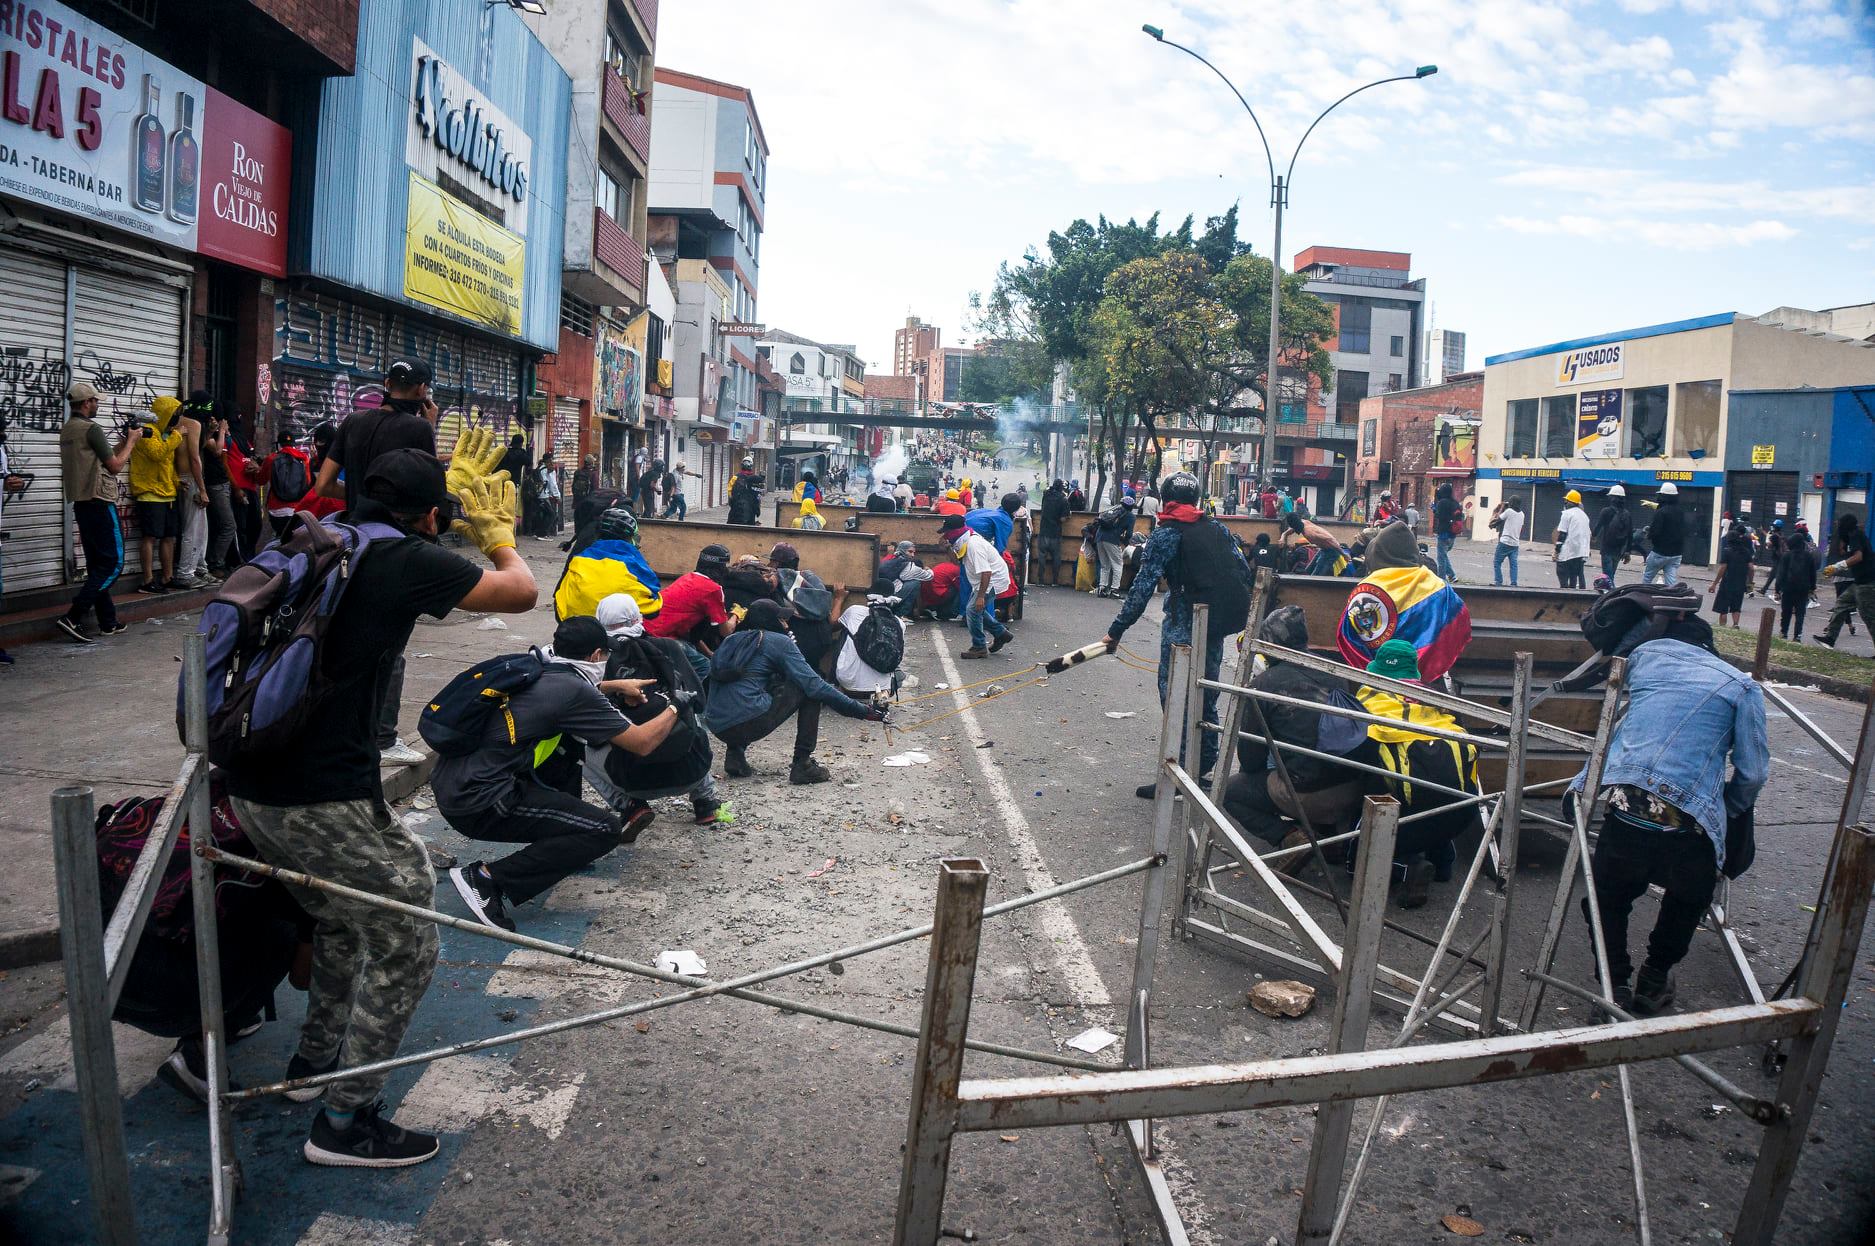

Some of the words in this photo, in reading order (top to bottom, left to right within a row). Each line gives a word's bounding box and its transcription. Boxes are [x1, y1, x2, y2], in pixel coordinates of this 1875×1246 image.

[3, 50, 65, 139] LA
[77, 86, 103, 152] 5
[31, 155, 95, 193] TABERNA
[98, 179, 123, 203] BAR
[231, 141, 265, 185] RON
[61, 196, 80, 210] BEBIDAS
[213, 182, 278, 237] CALDAS
[424, 234, 438, 252] CON
[439, 242, 443, 254] 4
[444, 244, 471, 269] CUARTOS
[488, 264, 493, 279] Y
[492, 268, 514, 289] OFICINAS
[437, 219, 446, 235] SE
[447, 224, 472, 249] ALQUILA
[472, 238, 485, 257] ESTA
[486, 245, 506, 266] BODEGA
[449, 268, 460, 285] 316
[461, 273, 473, 290] 472
[729, 326, 765, 334] LICORES
[1579, 346, 1621, 368] USADOS
